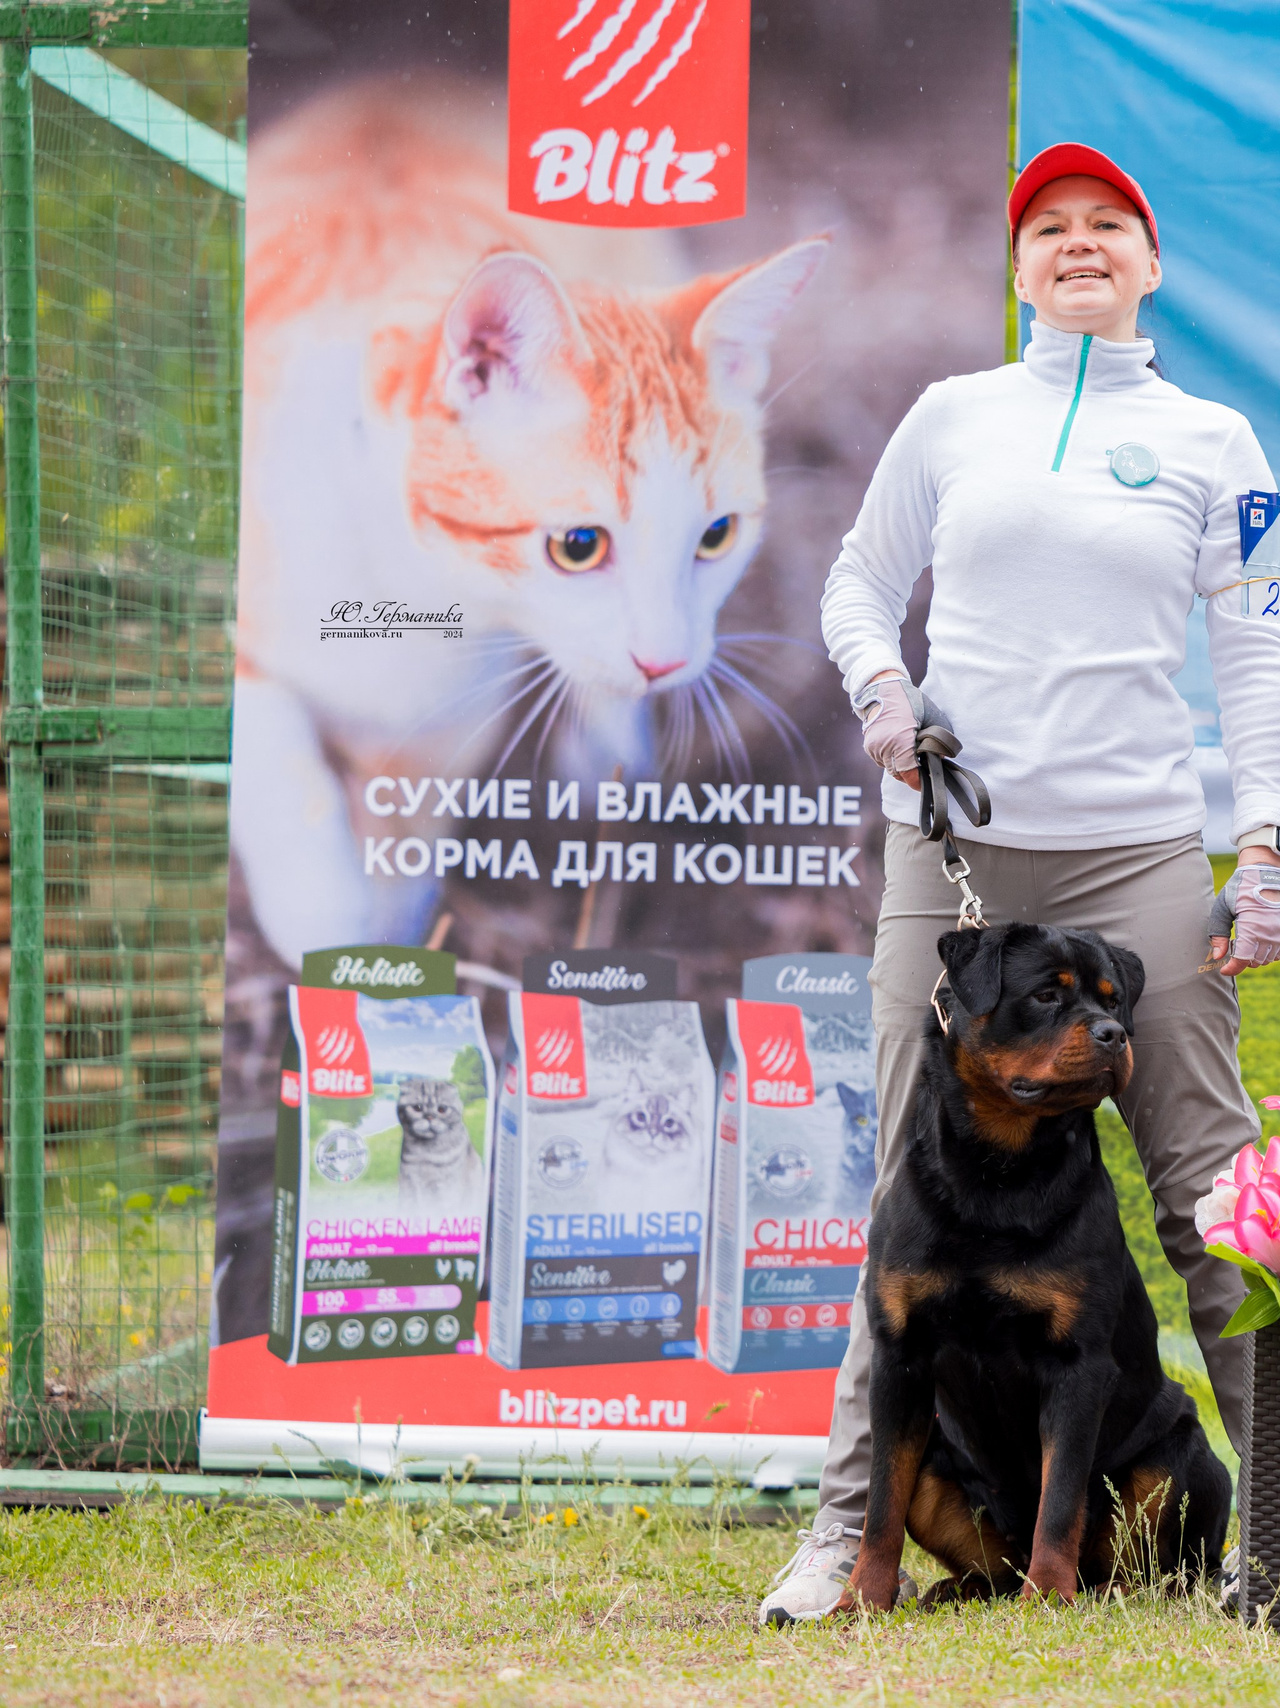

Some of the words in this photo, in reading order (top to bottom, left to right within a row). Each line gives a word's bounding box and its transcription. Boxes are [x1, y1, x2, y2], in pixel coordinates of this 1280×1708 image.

[529, 125, 719, 207] Blitz
[364, 776, 531, 819] СУХИЕ
[547, 780, 580, 821] И
[597, 781, 863, 827] ВЛАЖНЫЕ
[363, 837, 540, 880] КОРМА
[552, 841, 657, 888] ДЛЯ
[674, 843, 862, 887] КОШЕК
[330, 955, 426, 988] Holistic
[547, 959, 648, 991] Sensitive
[776, 965, 859, 995] Classic
[312, 1068, 366, 1092] Blitz
[530, 1071, 581, 1095] Blitz
[752, 1079, 808, 1103] Blitz
[526, 1211, 703, 1239] STERILISED
[499, 1389, 687, 1429] blitzpet.ru
